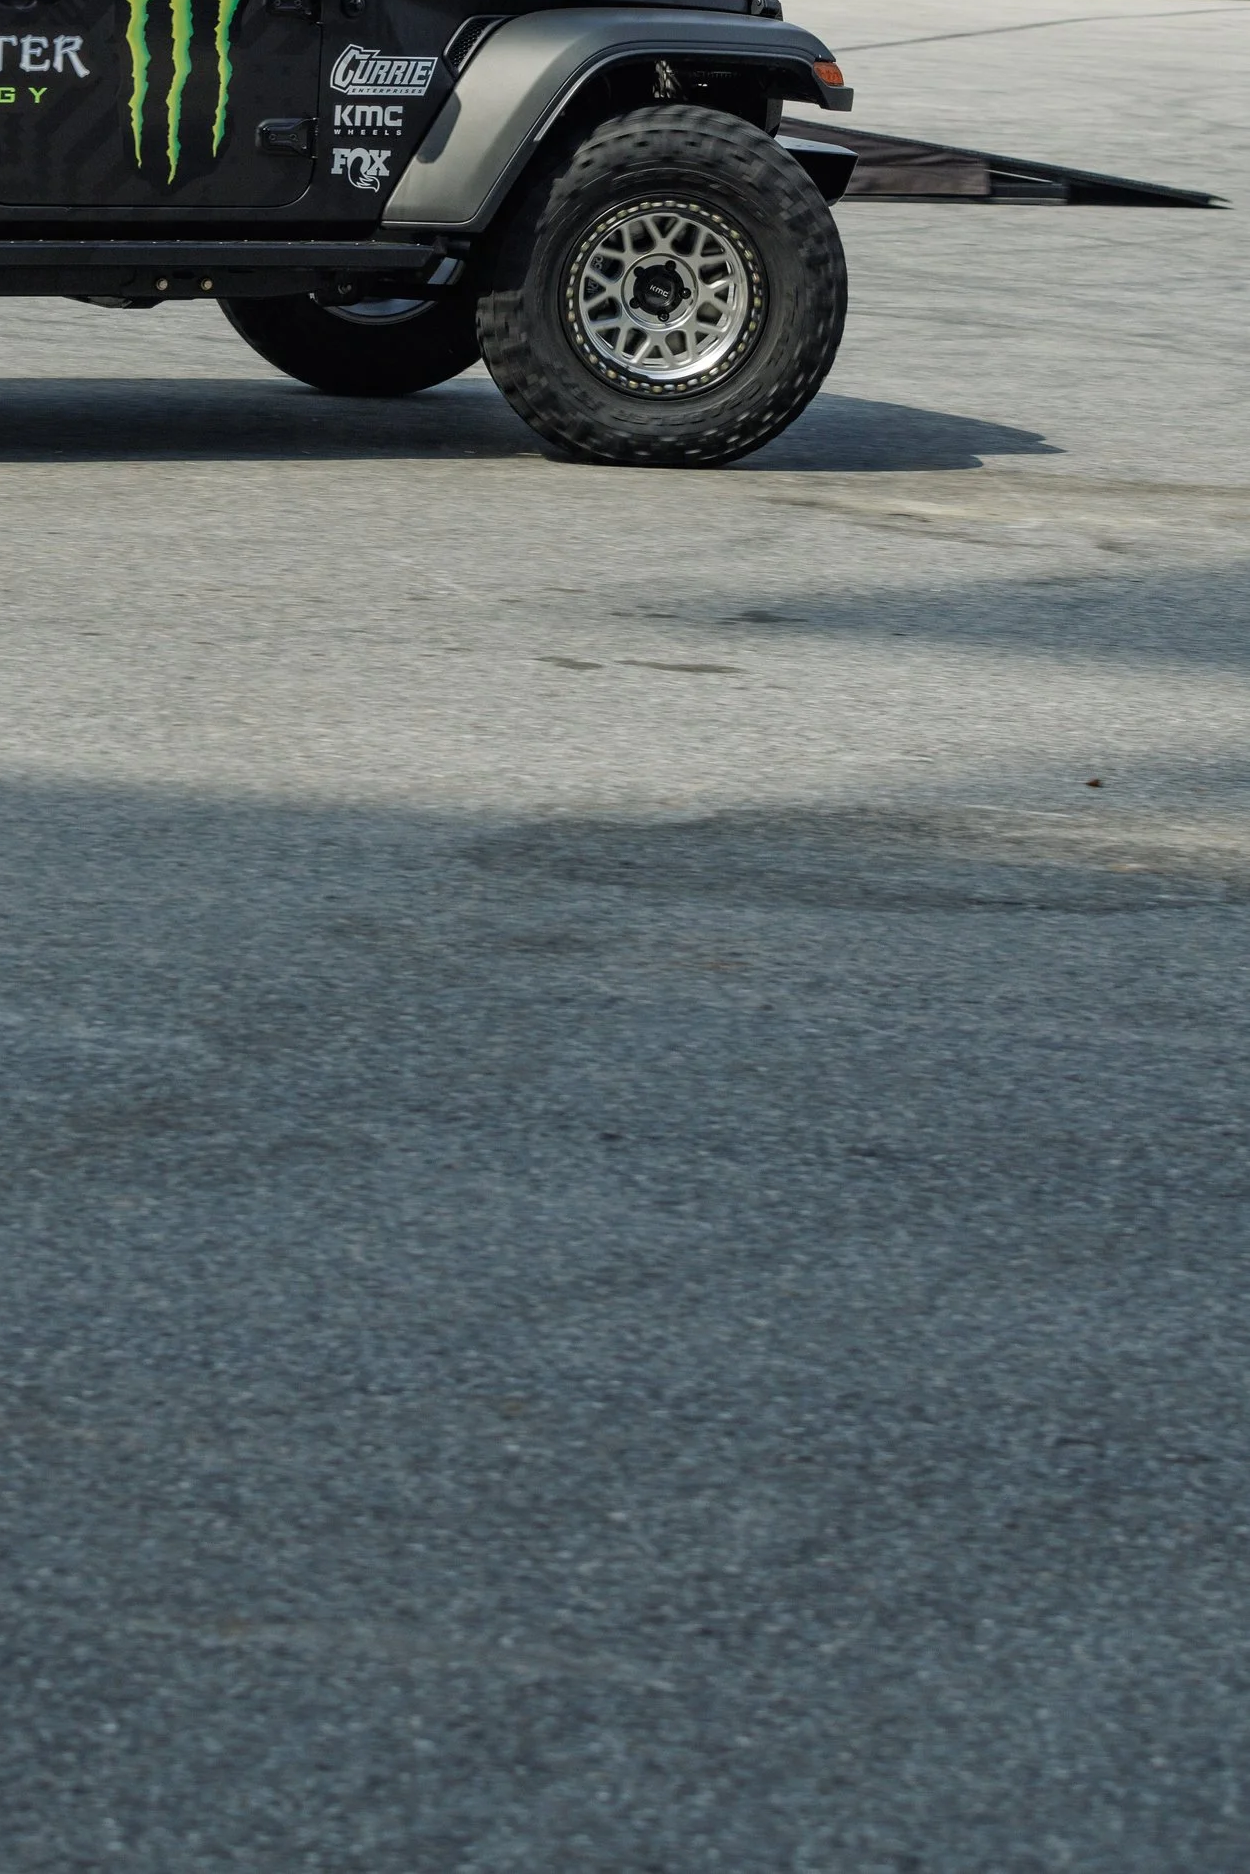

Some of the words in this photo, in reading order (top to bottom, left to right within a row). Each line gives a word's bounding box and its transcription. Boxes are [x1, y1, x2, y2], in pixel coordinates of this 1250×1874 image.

[334, 48, 433, 92] CURRIE
[334, 104, 403, 127] KMC
[331, 147, 391, 192] FOX
[649, 284, 669, 298] KMC
